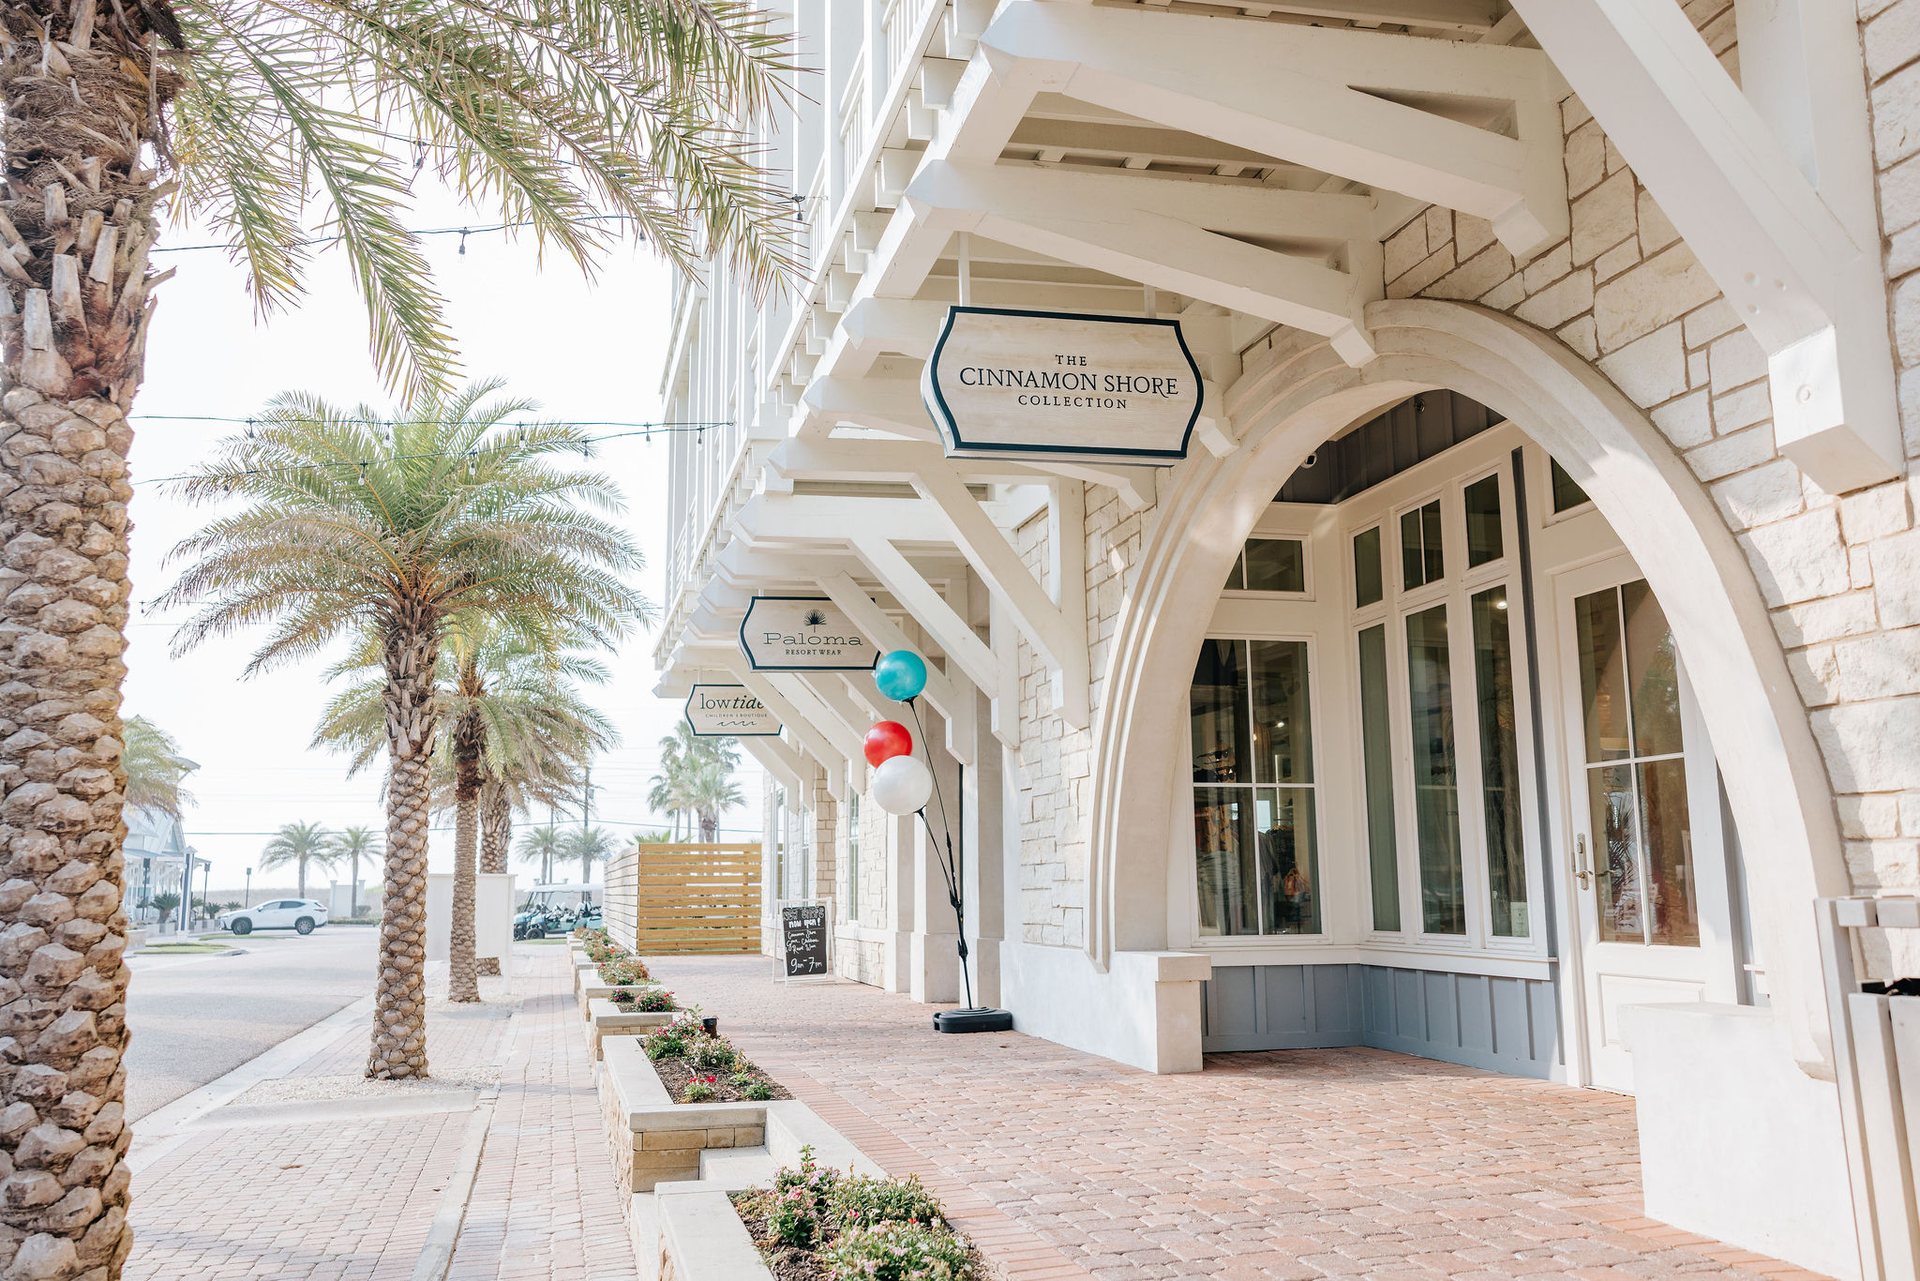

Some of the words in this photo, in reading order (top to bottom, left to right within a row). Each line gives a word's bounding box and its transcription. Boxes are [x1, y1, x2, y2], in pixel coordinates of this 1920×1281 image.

[1055, 354, 1087, 366] THE
[960, 367, 1097, 391] CINNAMON
[1104, 374, 1179, 398] SHORE
[1018, 395, 1127, 409] COLLECTION
[763, 632, 863, 646] Paloma
